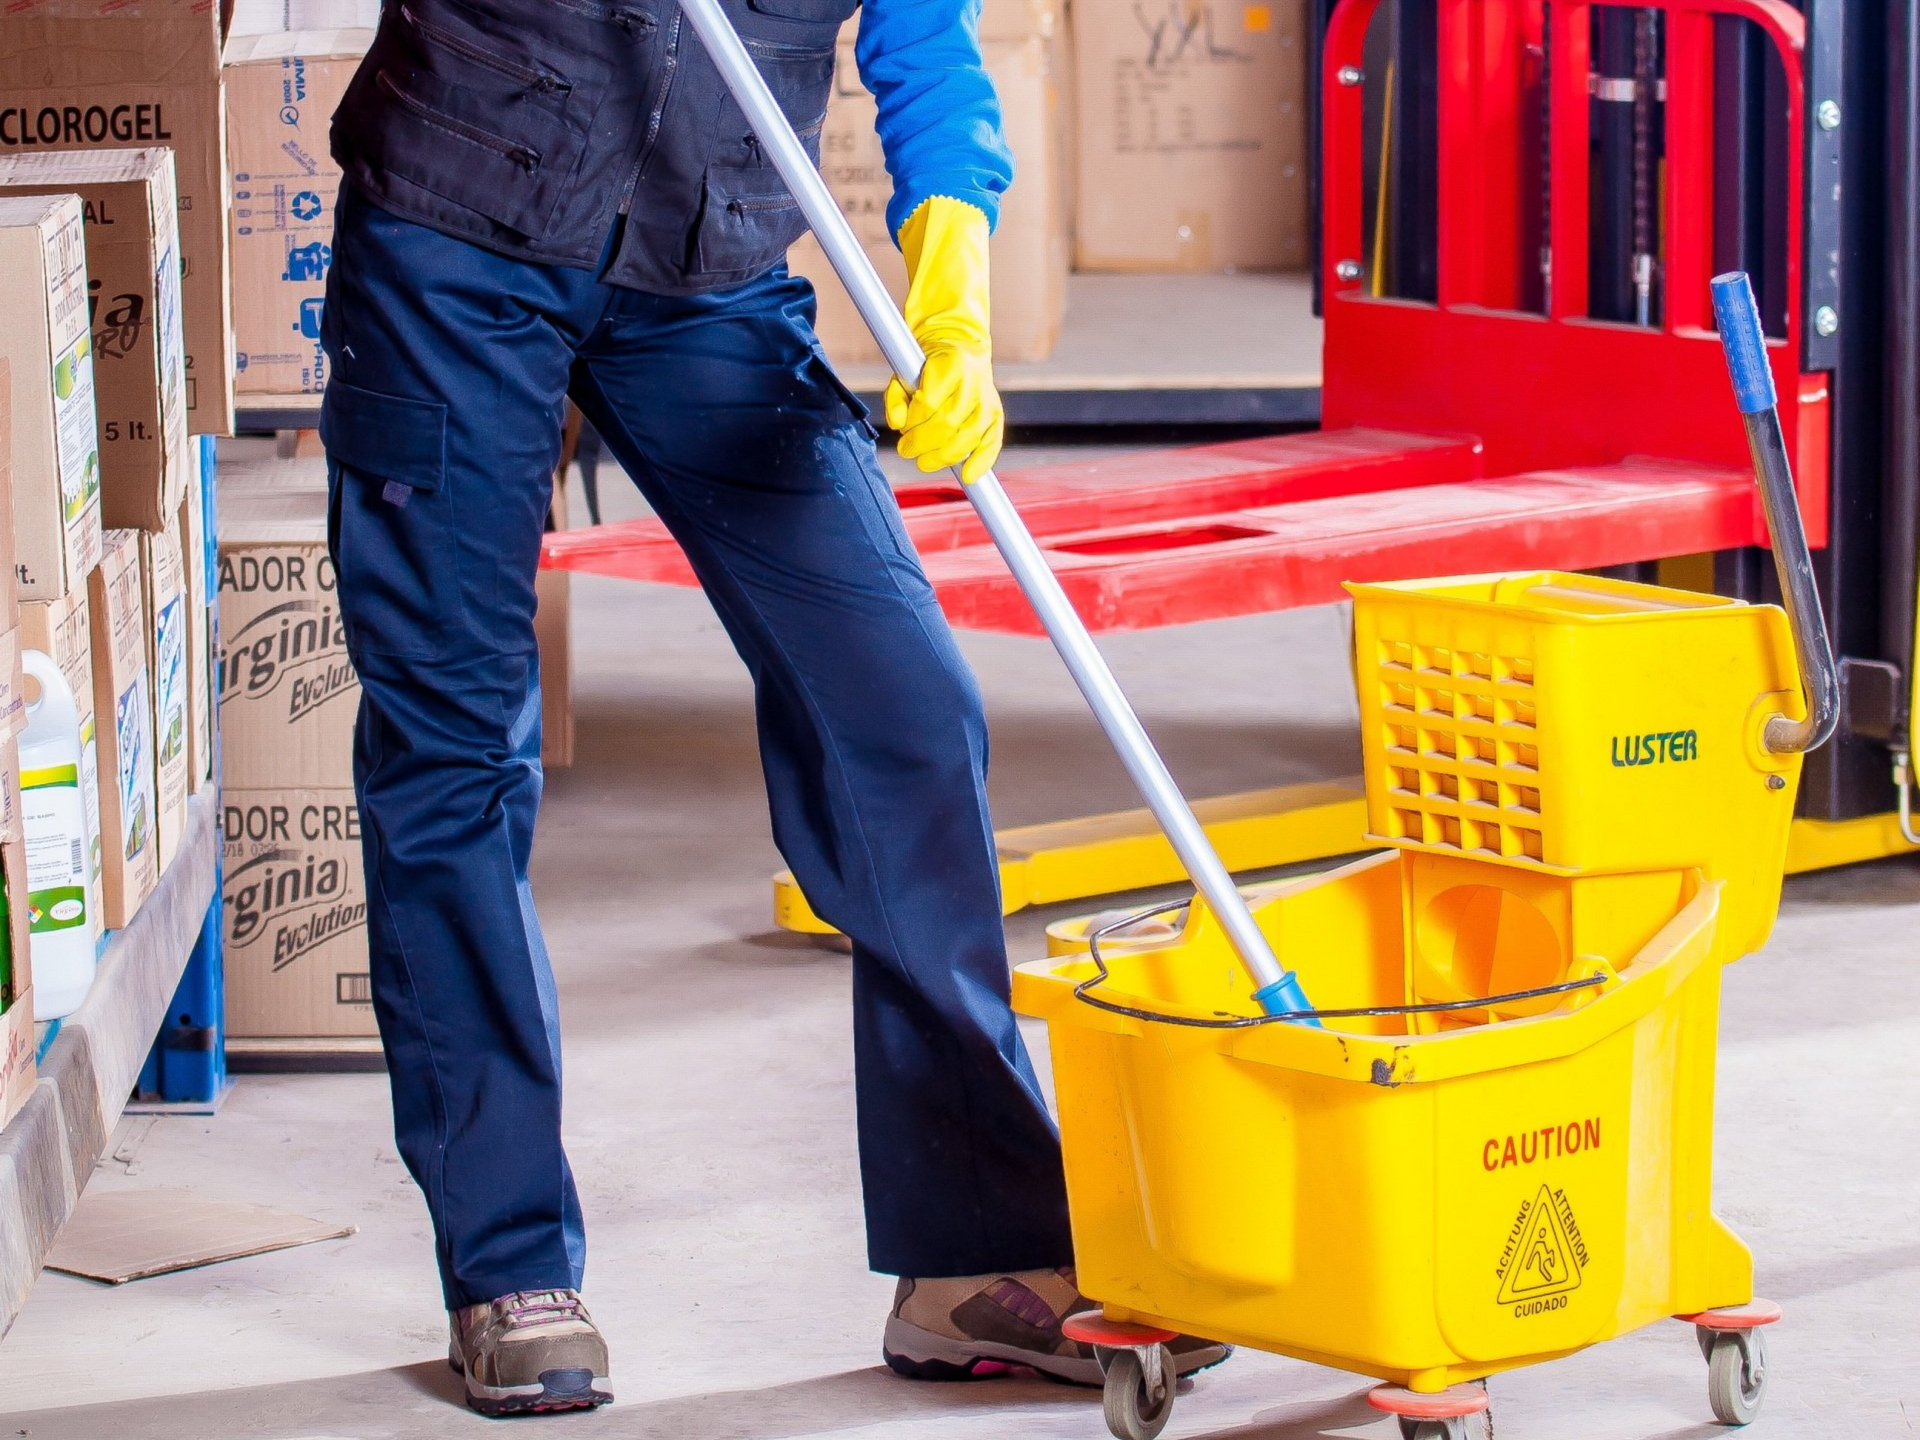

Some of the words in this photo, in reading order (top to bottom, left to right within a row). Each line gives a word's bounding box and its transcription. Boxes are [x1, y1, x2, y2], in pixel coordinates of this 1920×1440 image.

[0, 104, 171, 145] CLOROGEL
[105, 422, 119, 441] 5
[217, 556, 307, 592] ADOR
[1611, 729, 1697, 767] LUSTER
[1483, 1117, 1600, 1171] CAUTION
[1495, 1199, 1531, 1279] ACHTUNG
[1553, 1188, 1590, 1268] ATTENTION
[1514, 1295, 1568, 1318] CUIDADO
